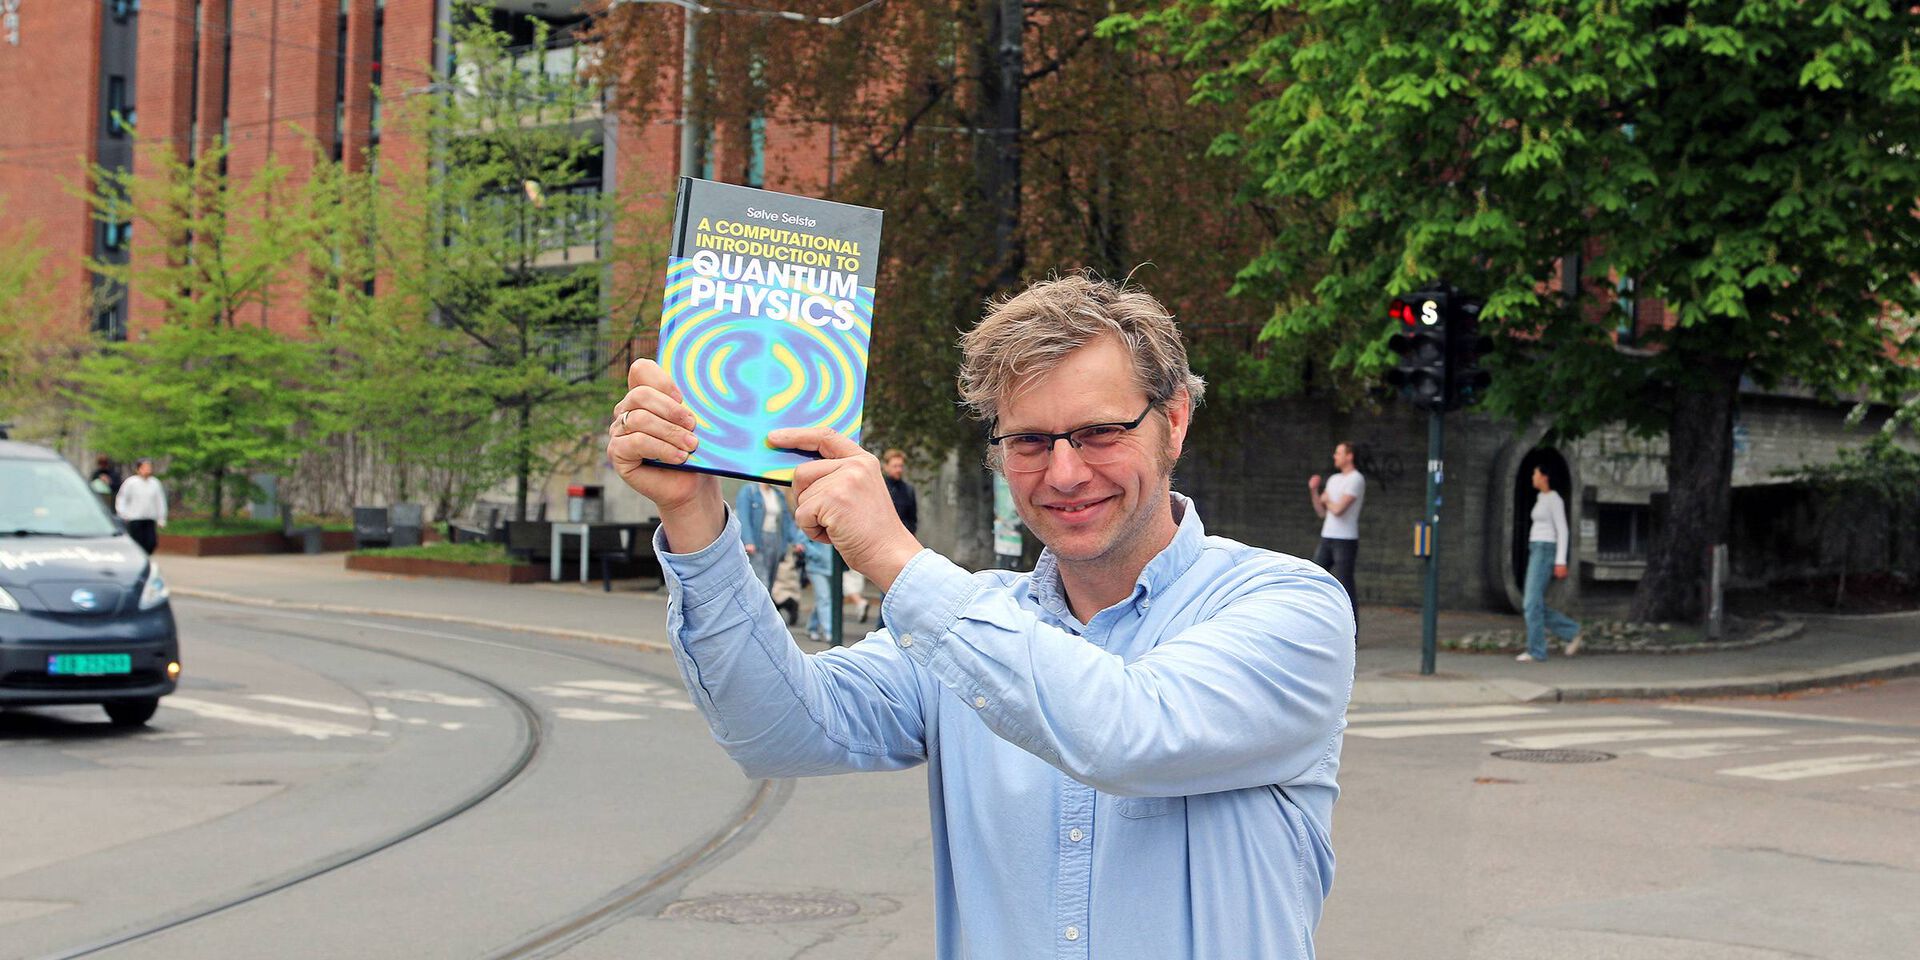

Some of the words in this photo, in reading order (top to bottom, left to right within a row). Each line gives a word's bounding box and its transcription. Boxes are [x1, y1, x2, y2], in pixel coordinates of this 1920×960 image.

[697, 217, 711, 232] A
[715, 220, 861, 256] COMPUTATIONAL
[746, 207, 779, 222] Sølve
[781, 210, 817, 228] Selstø
[695, 233, 832, 268] INTRODUCTION
[836, 256, 860, 272] TO
[692, 250, 859, 300] QUANTUM
[690, 276, 856, 331] PHYSICS
[1421, 300, 1438, 325] S
